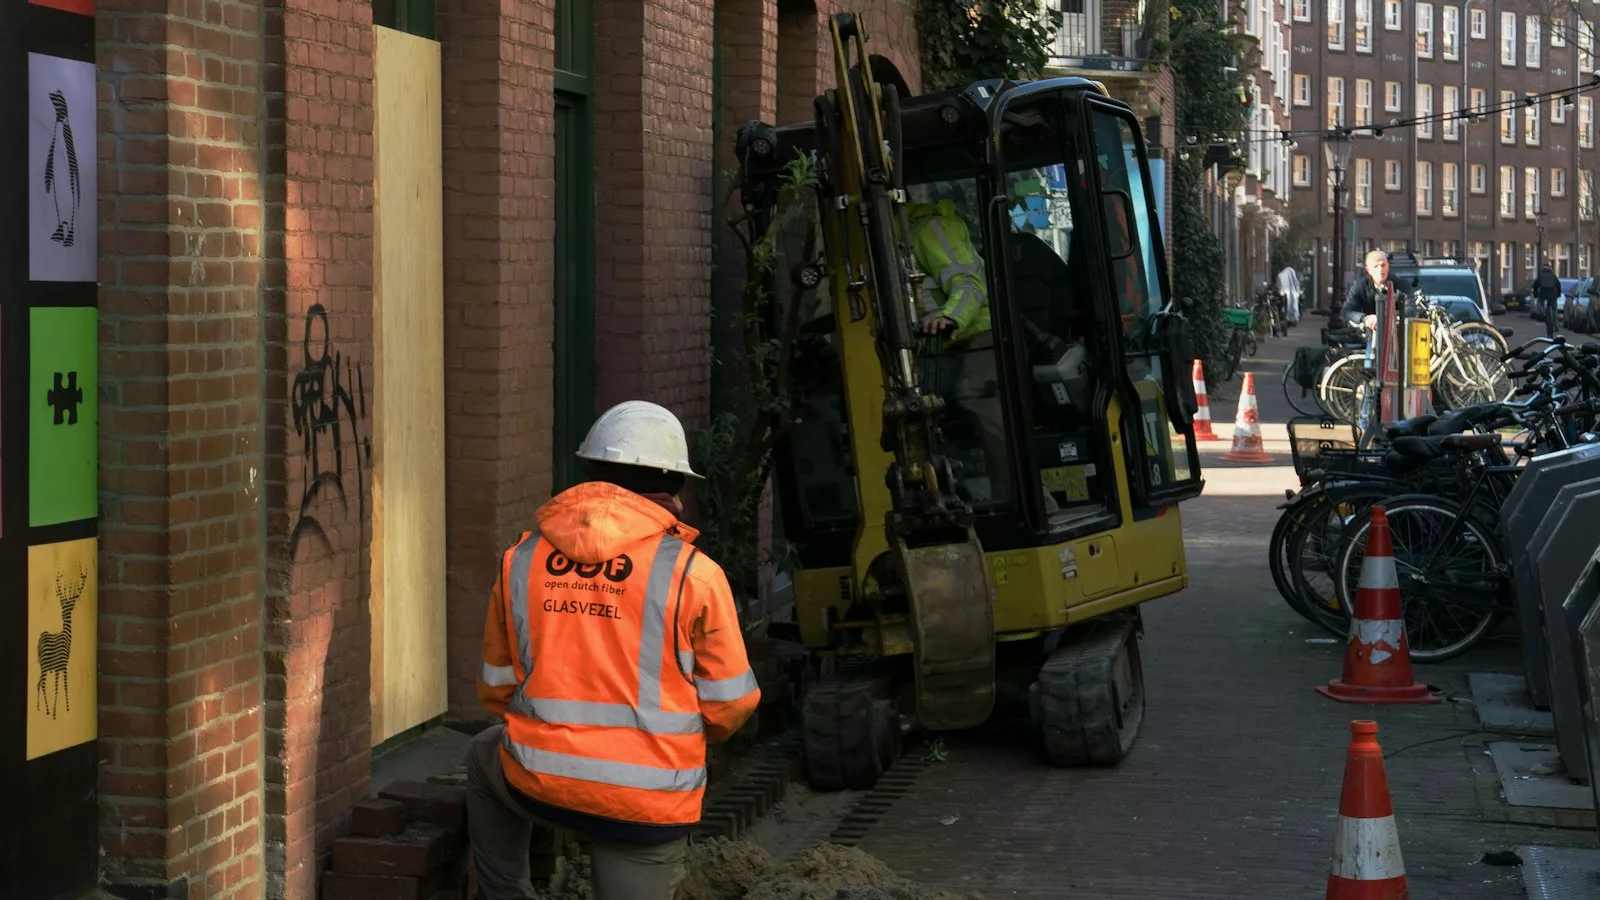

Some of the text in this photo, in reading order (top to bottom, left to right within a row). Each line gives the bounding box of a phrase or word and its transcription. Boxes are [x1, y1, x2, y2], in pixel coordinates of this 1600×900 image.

[545, 581, 625, 595] open dutch fiber
[543, 599, 622, 620] GLASVEZEL
